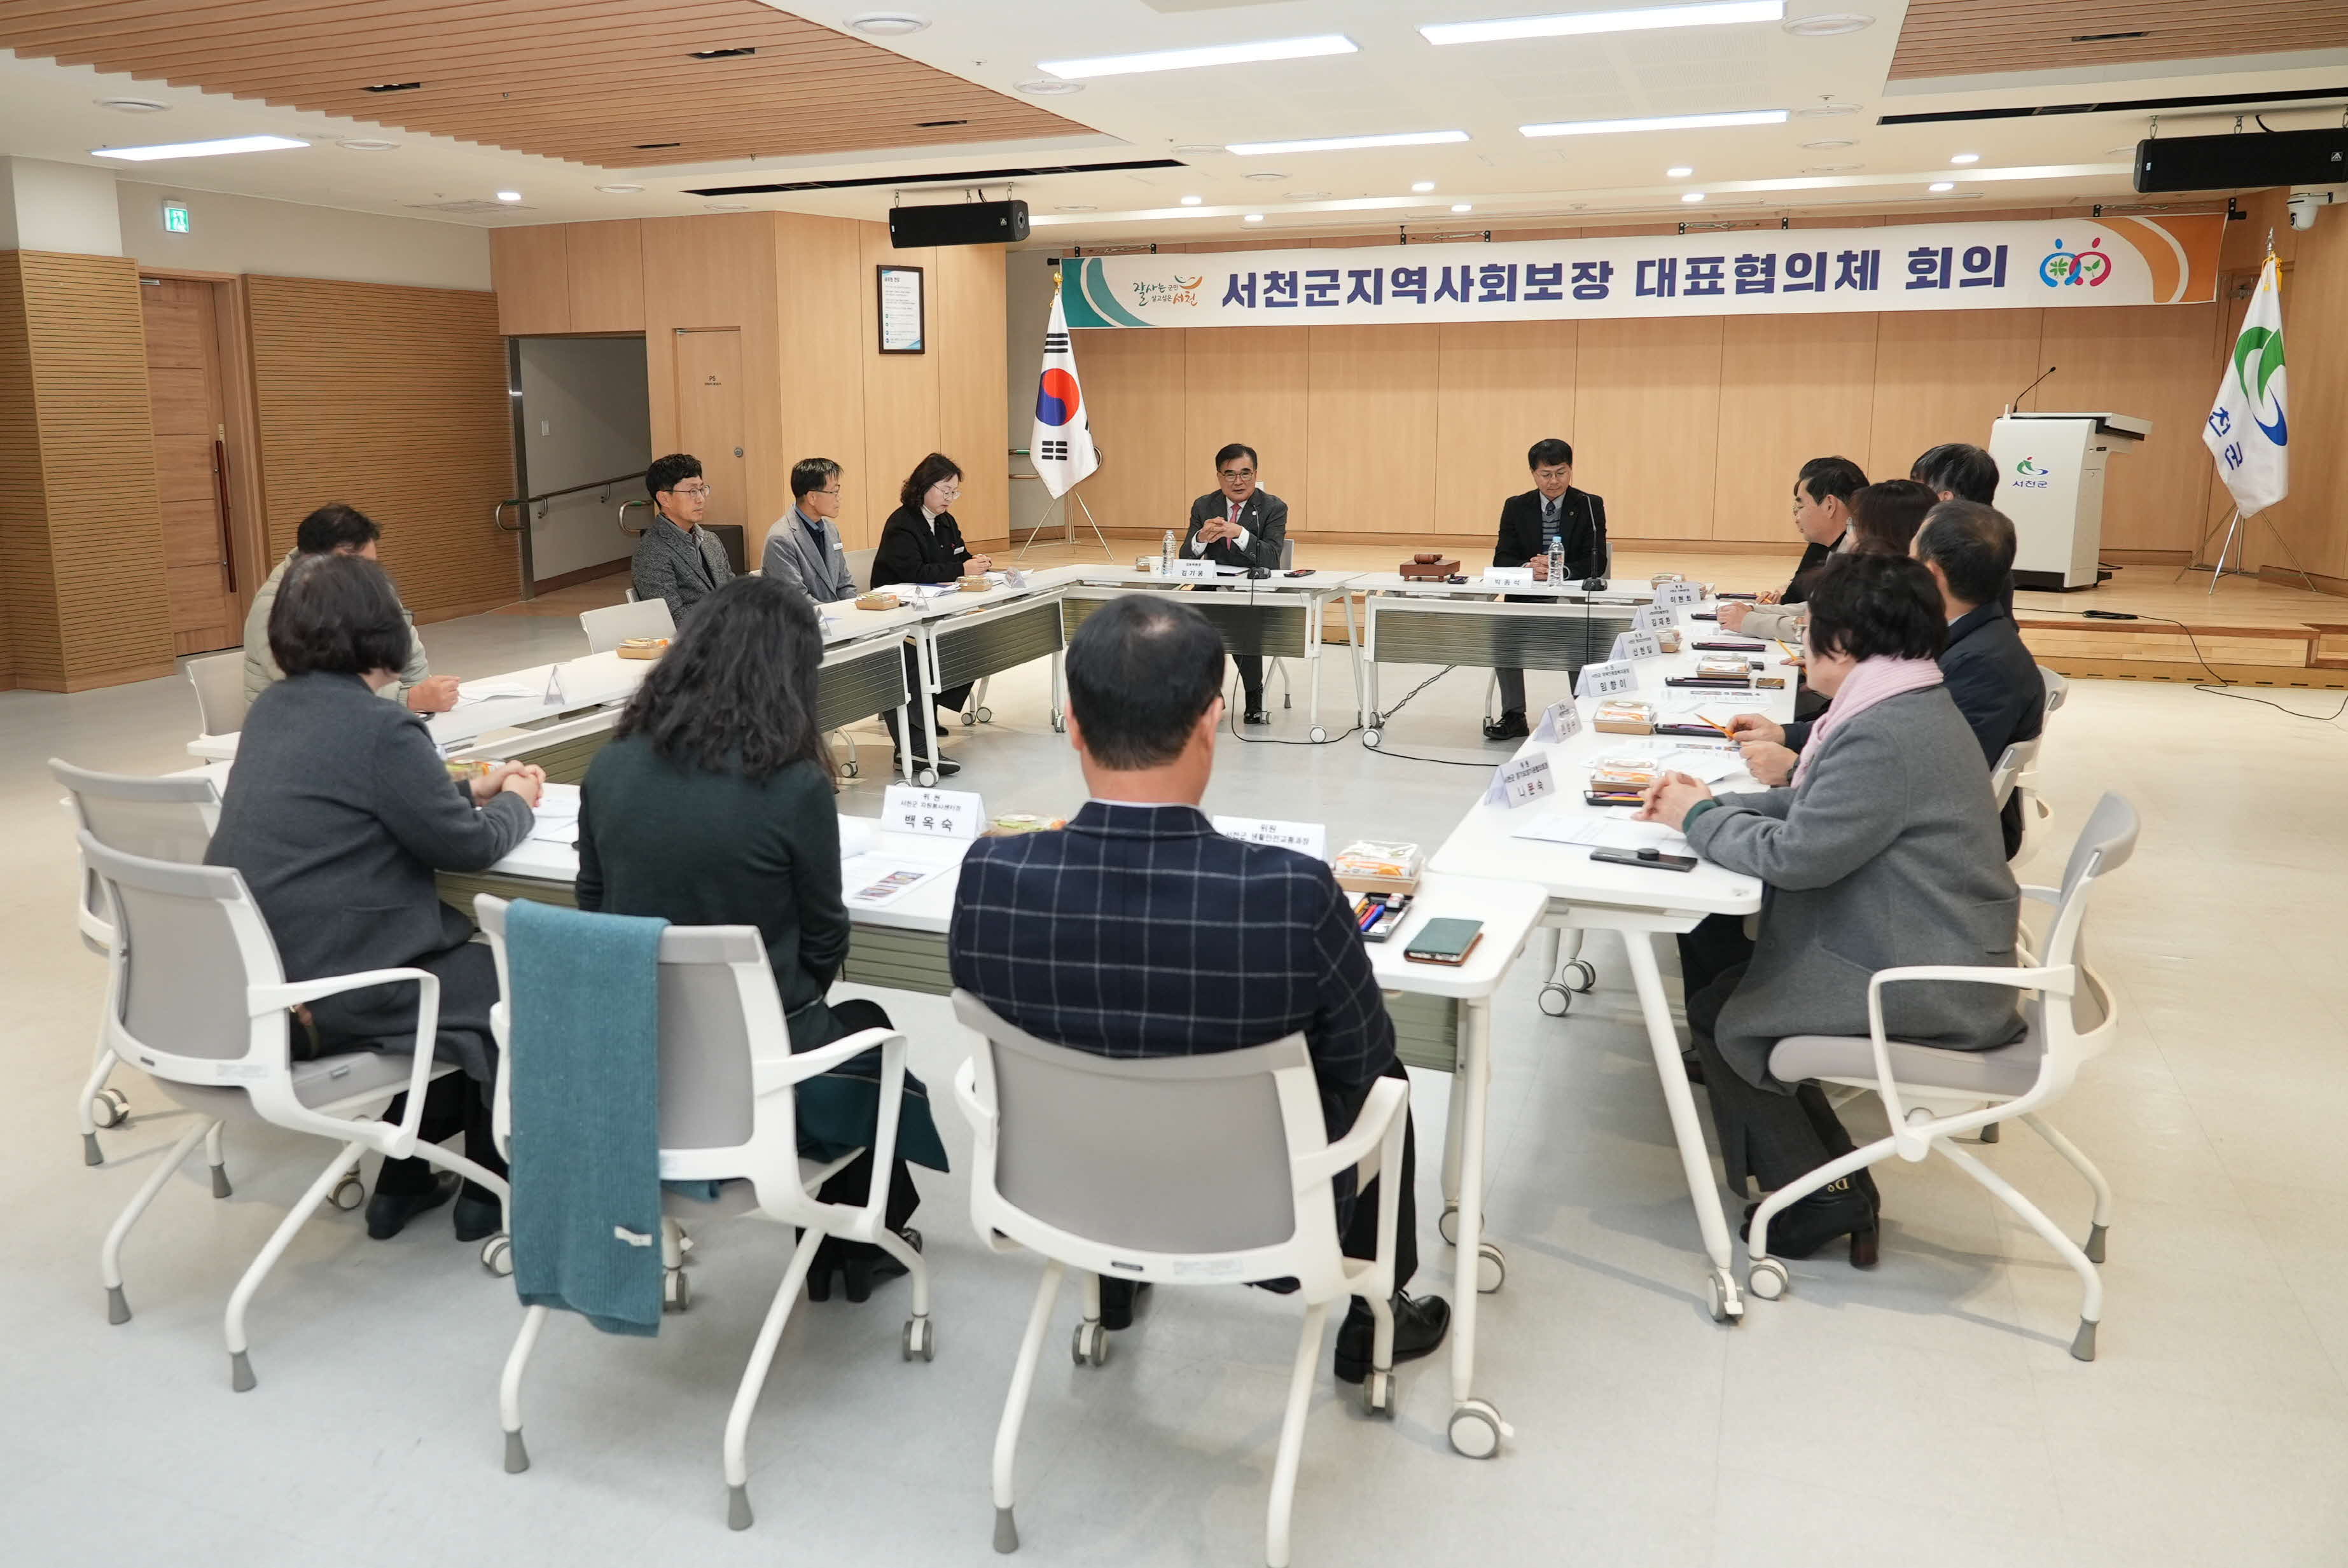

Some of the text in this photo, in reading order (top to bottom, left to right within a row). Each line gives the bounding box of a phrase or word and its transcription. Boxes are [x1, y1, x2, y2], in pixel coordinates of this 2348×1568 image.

[1222, 246, 2008, 309] 서천군지역사회보장 대표협의체 회의
[1132, 281, 1166, 306] 잘사는
[1172, 291, 1197, 306] 서천
[905, 815, 952, 832] 백옥숙
